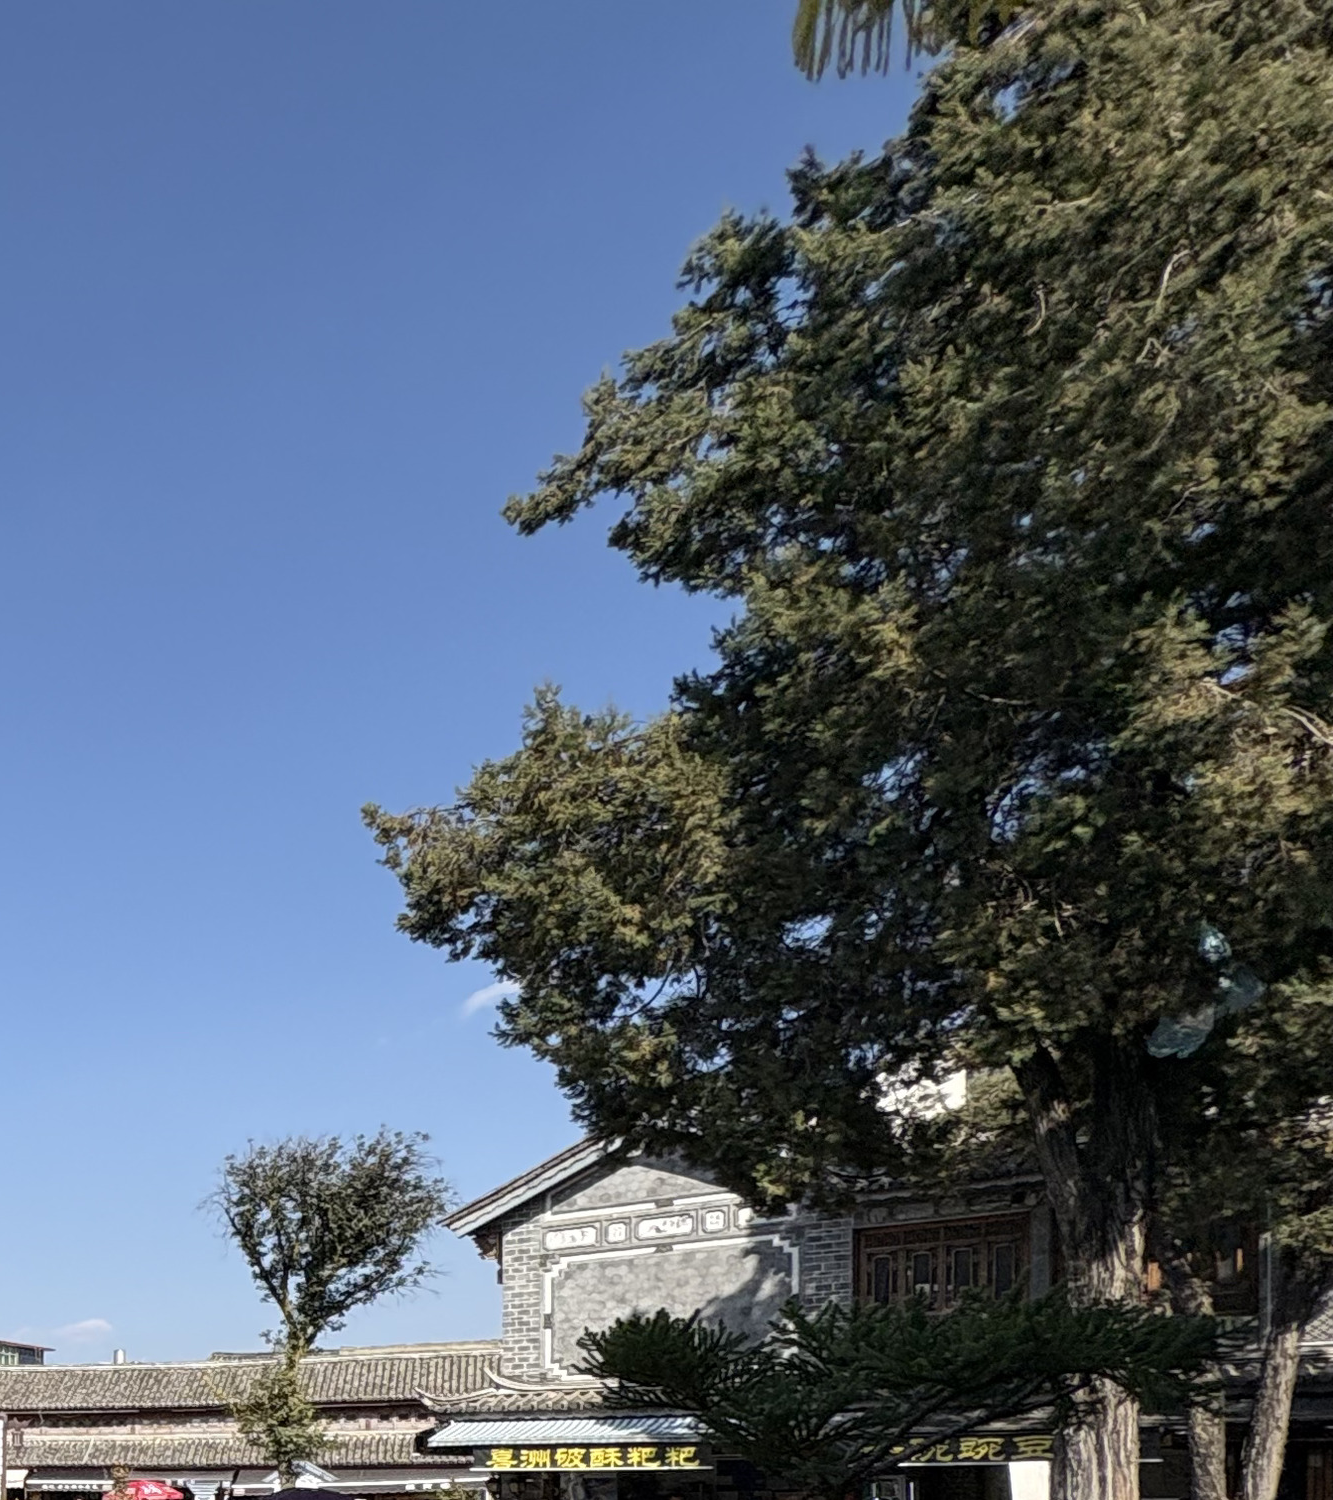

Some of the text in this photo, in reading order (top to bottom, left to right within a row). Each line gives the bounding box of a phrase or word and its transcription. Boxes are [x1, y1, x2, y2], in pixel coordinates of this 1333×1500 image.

[486, 1447, 701, 1469] 喜洲破酥粑粑
